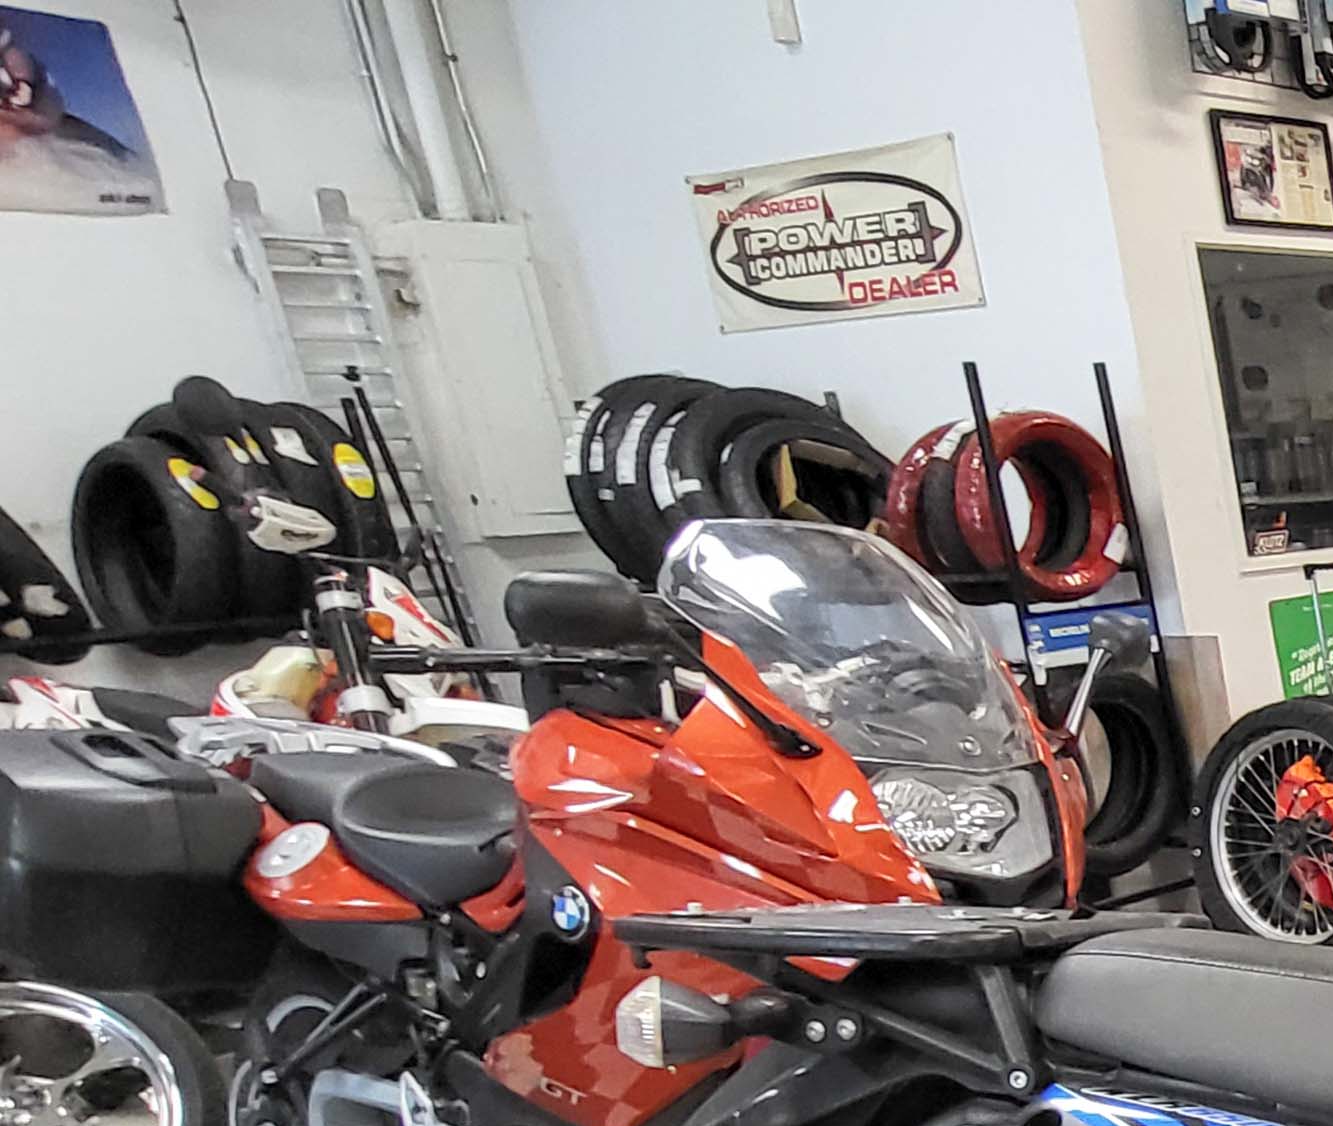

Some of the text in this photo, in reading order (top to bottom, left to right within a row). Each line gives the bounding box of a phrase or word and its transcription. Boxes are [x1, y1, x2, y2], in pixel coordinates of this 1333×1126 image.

[717, 195, 820, 224] AUTHORIZED
[748, 210, 919, 256] POWER
[757, 238, 915, 282] COMMANDER
[848, 269, 960, 304] DEALER
[540, 1077, 588, 1104] GT
